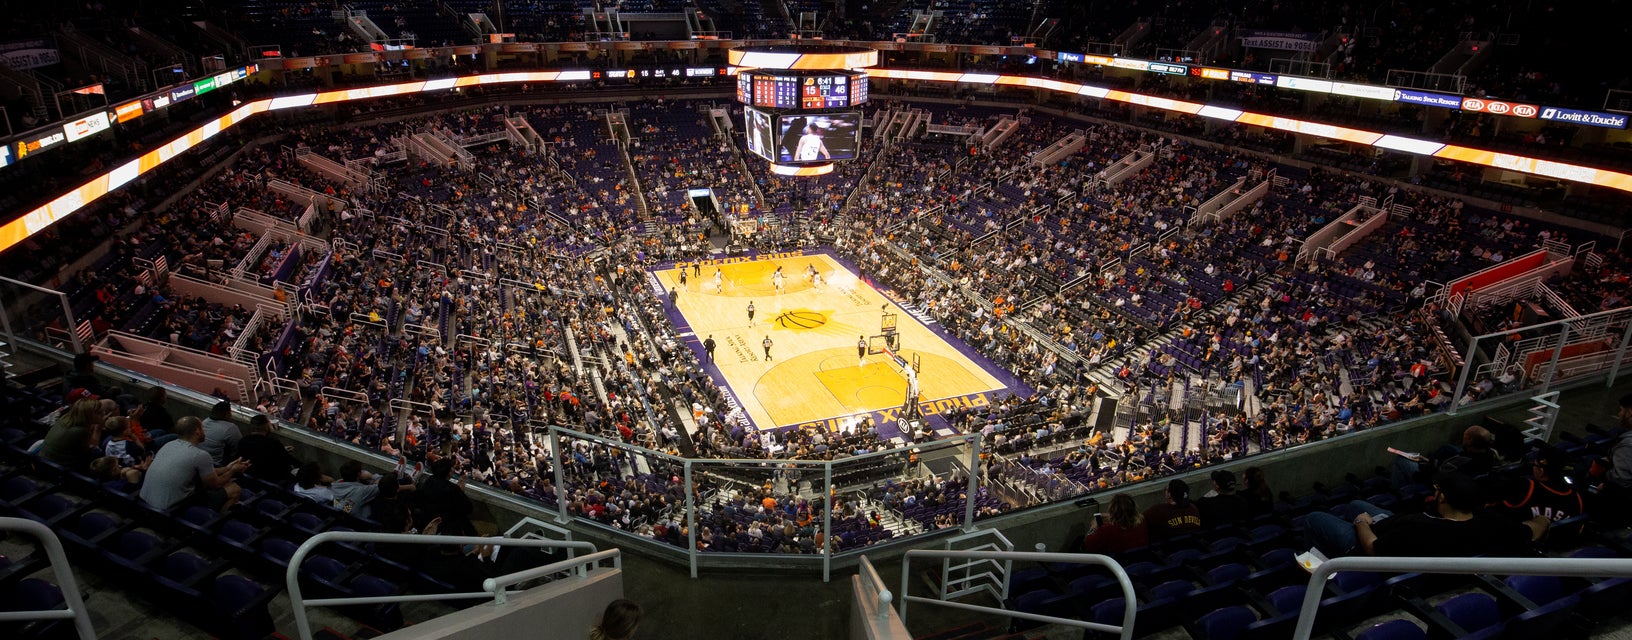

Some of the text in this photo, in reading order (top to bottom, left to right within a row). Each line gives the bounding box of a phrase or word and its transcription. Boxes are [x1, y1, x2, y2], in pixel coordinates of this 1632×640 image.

[1244, 38, 1258, 46] Text
[1258, 39, 1283, 48] ASSIST
[9, 54, 31, 68] SSIST
[818, 77, 831, 85] 6:41
[806, 86, 816, 95] 15
[835, 85, 845, 94] 46
[1556, 110, 1581, 122] Lovitt
[1590, 115, 1624, 127] Touché
[1531, 506, 1571, 521] NAS
[1168, 516, 1182, 527] SUN
